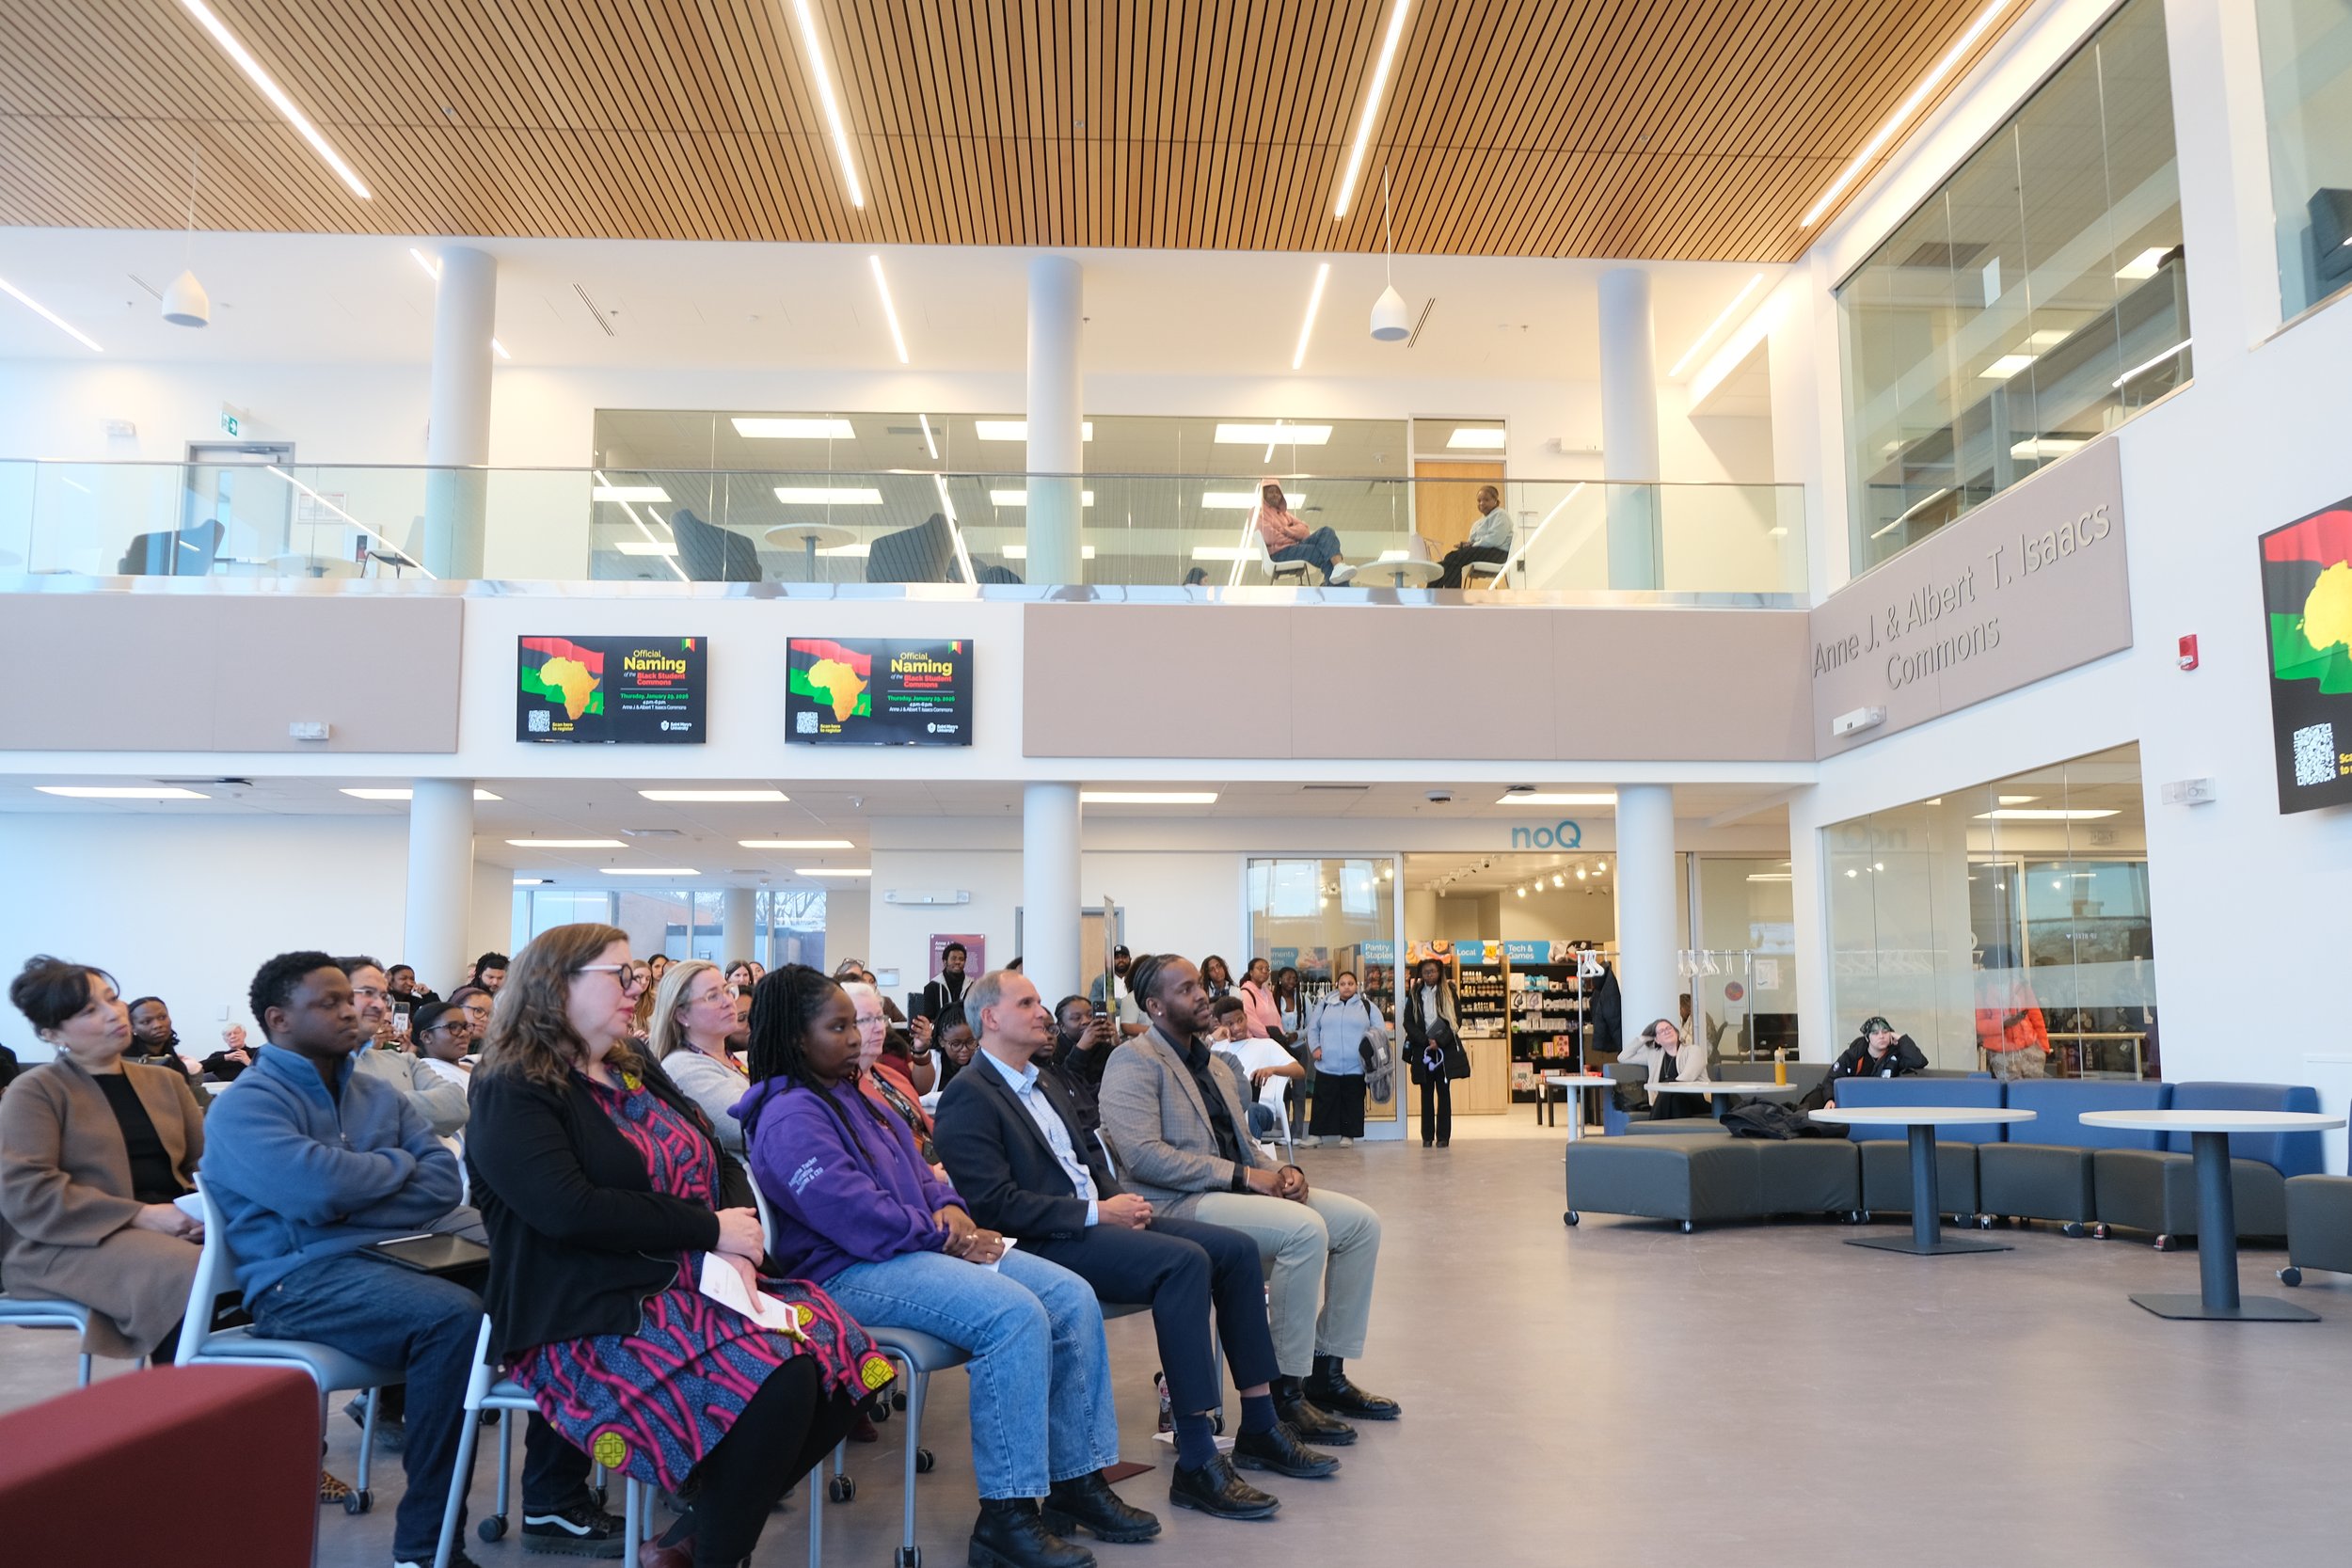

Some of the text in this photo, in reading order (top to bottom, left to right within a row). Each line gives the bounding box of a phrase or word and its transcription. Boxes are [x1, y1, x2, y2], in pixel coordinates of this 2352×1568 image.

[1813, 503, 2111, 678] Anne J. & Albert T. Isaacs
[633, 649, 661, 657] Official
[900, 652, 928, 660] Official
[1886, 616, 2001, 690] Commons
[624, 657, 686, 673] Naming
[891, 659, 953, 676] Naming
[2340, 766, 2350, 775] to
[1511, 820, 1581, 848] noQ
[1365, 942, 1390, 952] Pantry
[1365, 952, 1393, 960] Staples
